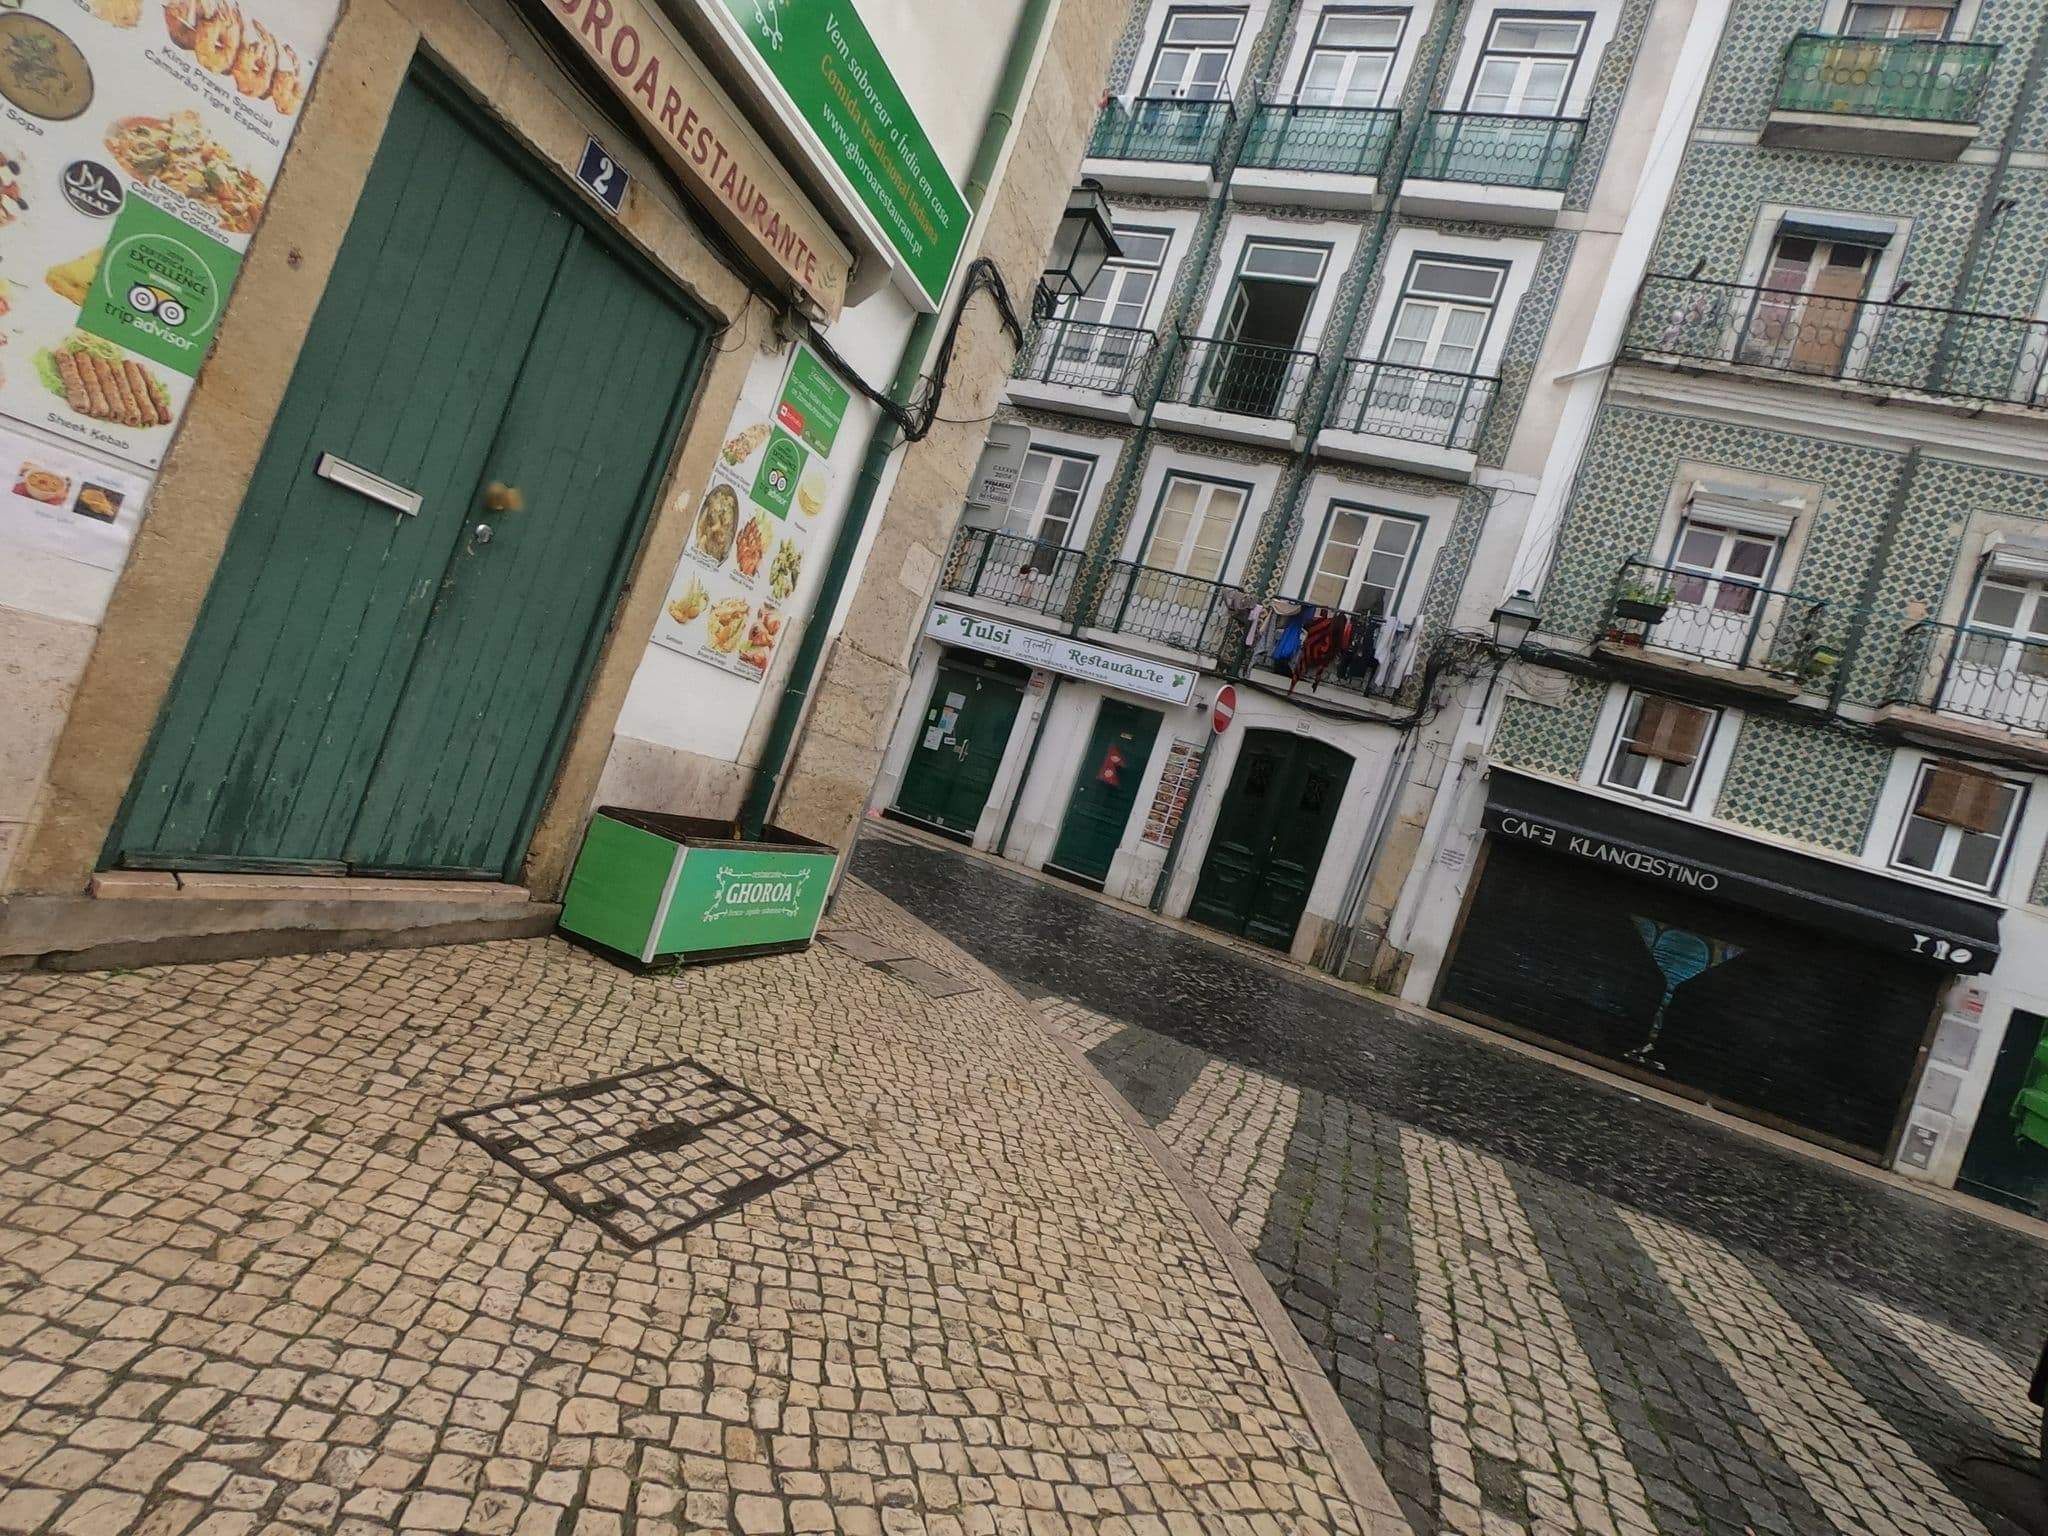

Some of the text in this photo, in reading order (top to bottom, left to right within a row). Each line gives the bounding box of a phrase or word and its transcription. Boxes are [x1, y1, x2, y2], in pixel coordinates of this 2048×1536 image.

[161, 46, 273, 129] King Prawn Special
[6, 108, 44, 136] Sopa
[203, 88, 231, 114] Tigre
[233, 110, 280, 147] Especial
[821, 54, 861, 125] Comida
[861, 119, 911, 200] tradicional
[826, 12, 949, 229] Vem saborear a Índia em casa.
[558, 0, 817, 285] ROA RESTAURANTE
[591, 157, 614, 195] 2
[823, 102, 923, 258] www.ghoroarestaurant.pt
[151, 177, 220, 226] Lamb Curry
[163, 201, 177, 215] de
[180, 210, 230, 244] Cordeiro
[129, 249, 208, 297] EXCELLENCE
[104, 302, 198, 350] tripadvisor
[47, 412, 130, 450] Sheek Kebab
[960, 617, 1011, 644] Tulsi
[1069, 648, 1164, 683] Restaurante
[726, 882, 792, 904] GHOROA
